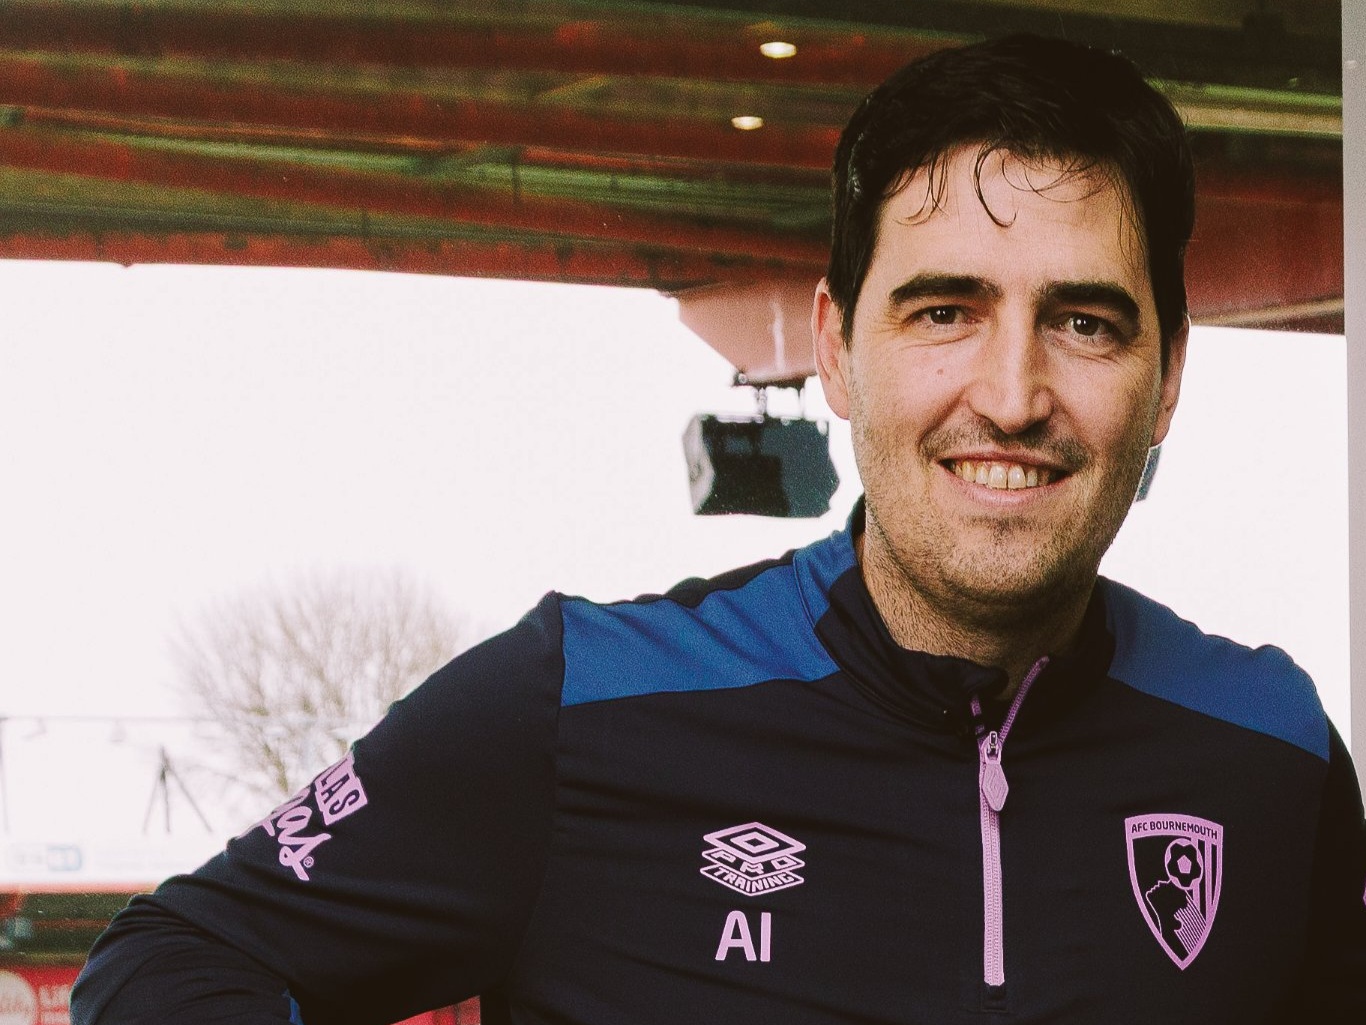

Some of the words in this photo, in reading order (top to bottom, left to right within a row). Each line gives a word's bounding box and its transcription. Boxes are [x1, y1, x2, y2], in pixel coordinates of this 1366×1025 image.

[1131, 822, 1148, 834] AFC
[1149, 820, 1218, 840] BOURNEMOUTH
[710, 850, 798, 875] PRO
[714, 866, 795, 893] TRAINING
[714, 910, 772, 962] AI
